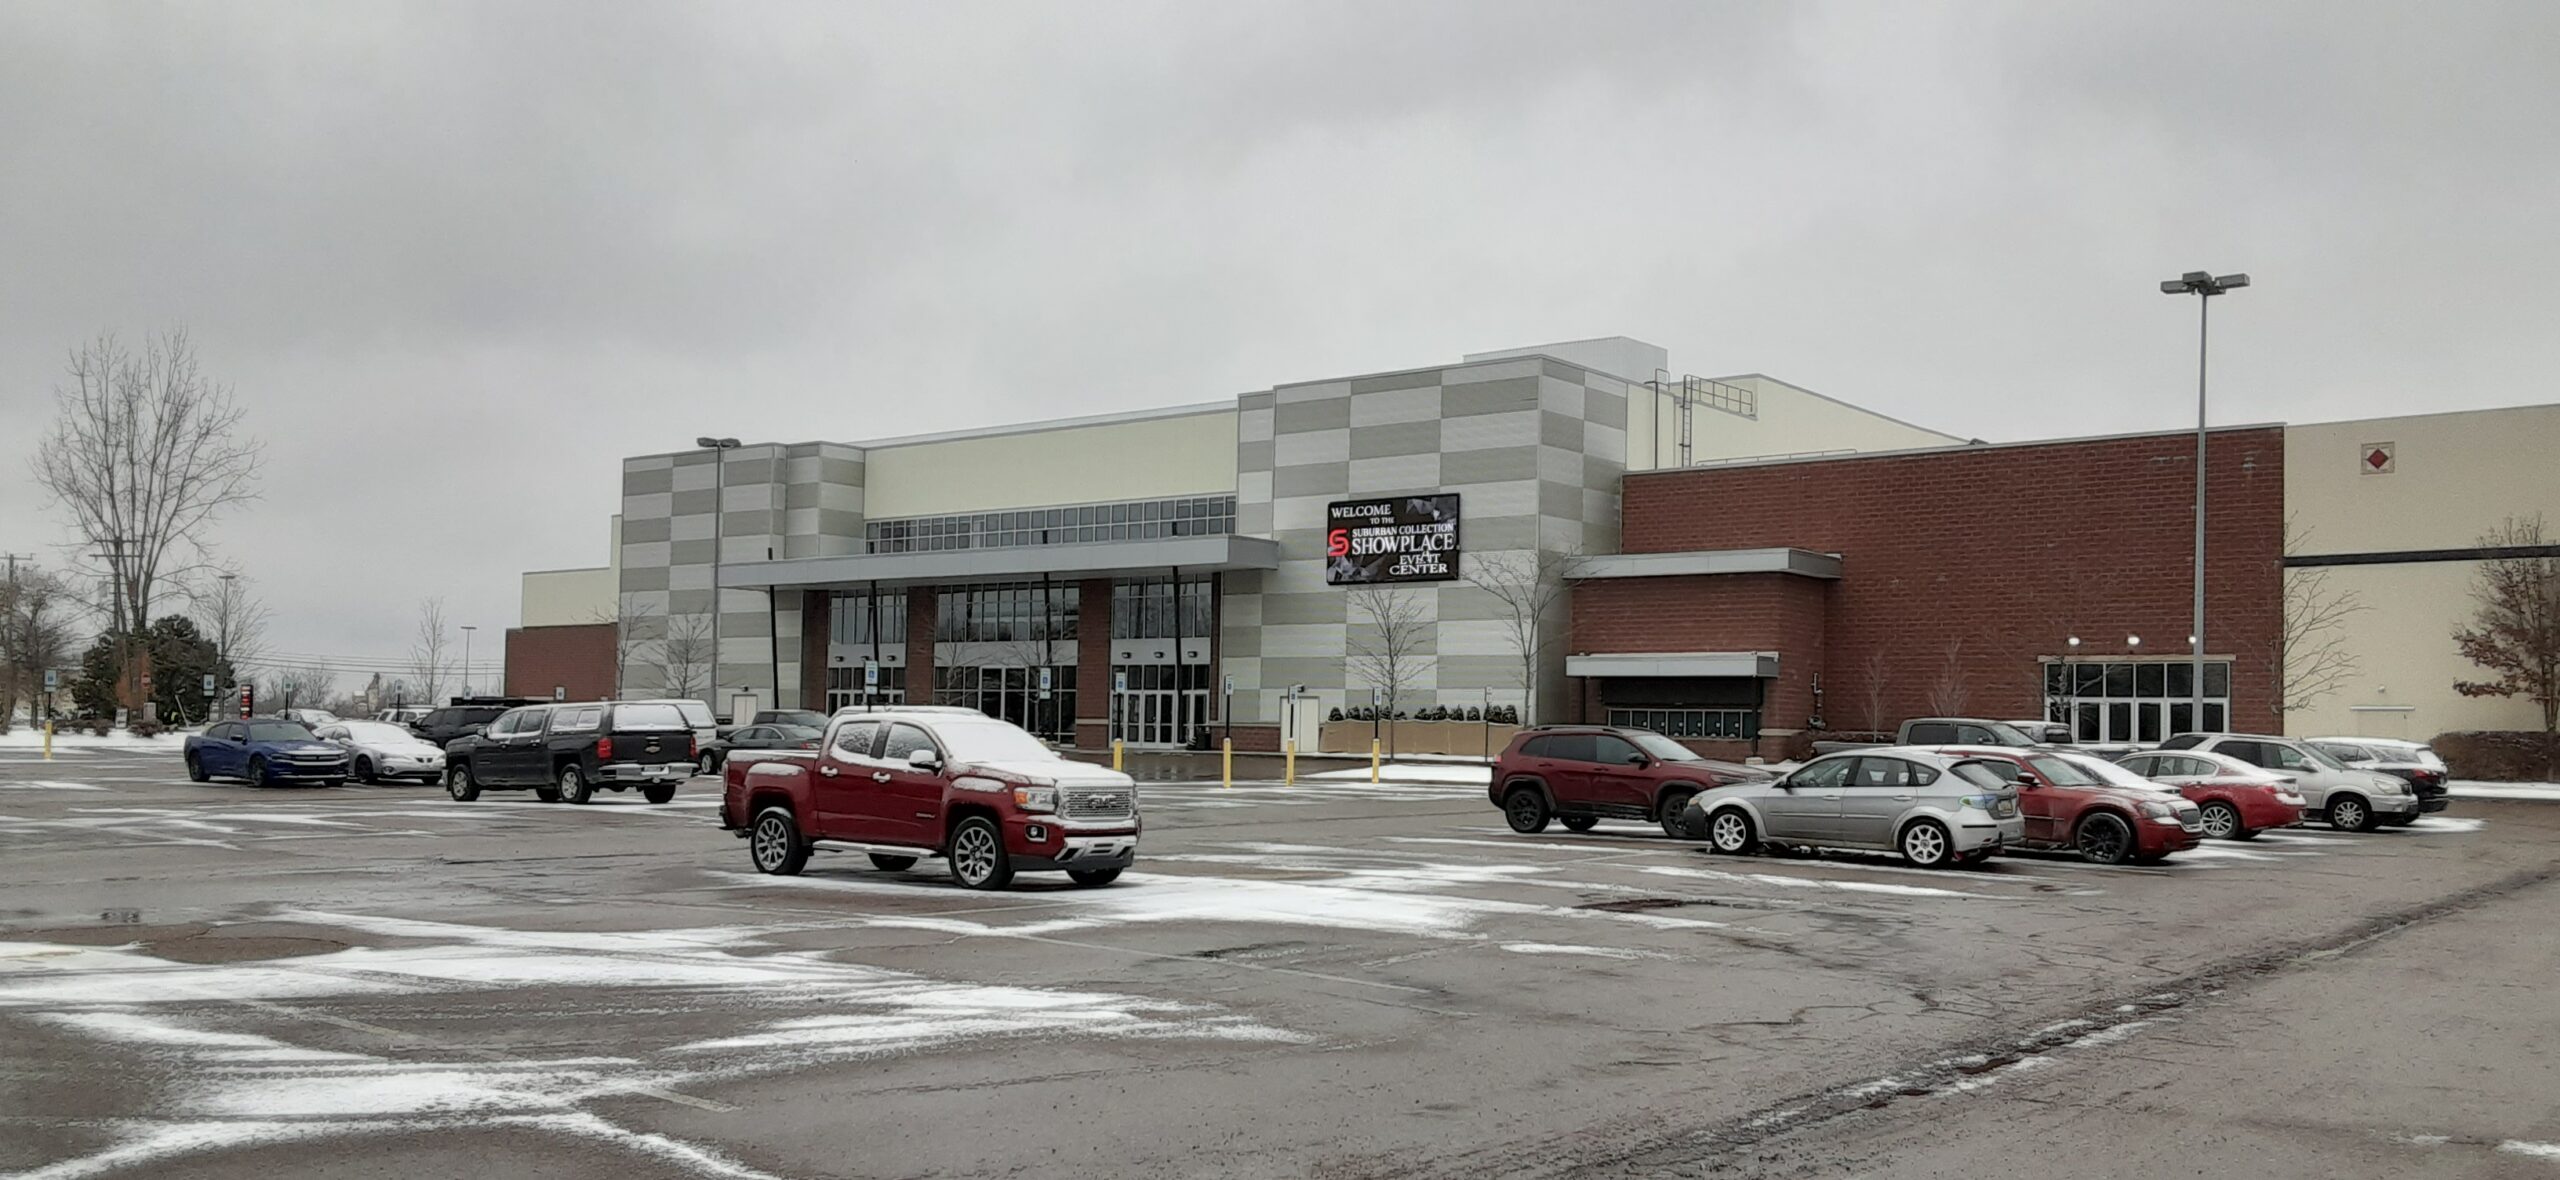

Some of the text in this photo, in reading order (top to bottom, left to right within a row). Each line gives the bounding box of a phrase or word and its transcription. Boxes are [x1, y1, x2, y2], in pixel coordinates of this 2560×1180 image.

[1331, 504, 1392, 518] WELCOME
[1370, 517, 1380, 525] TO
[1352, 523, 1455, 538] SUBURBAN COLLECTION
[1352, 533, 1455, 555] SHOWPLACE
[1389, 563, 1448, 575] CENTER
